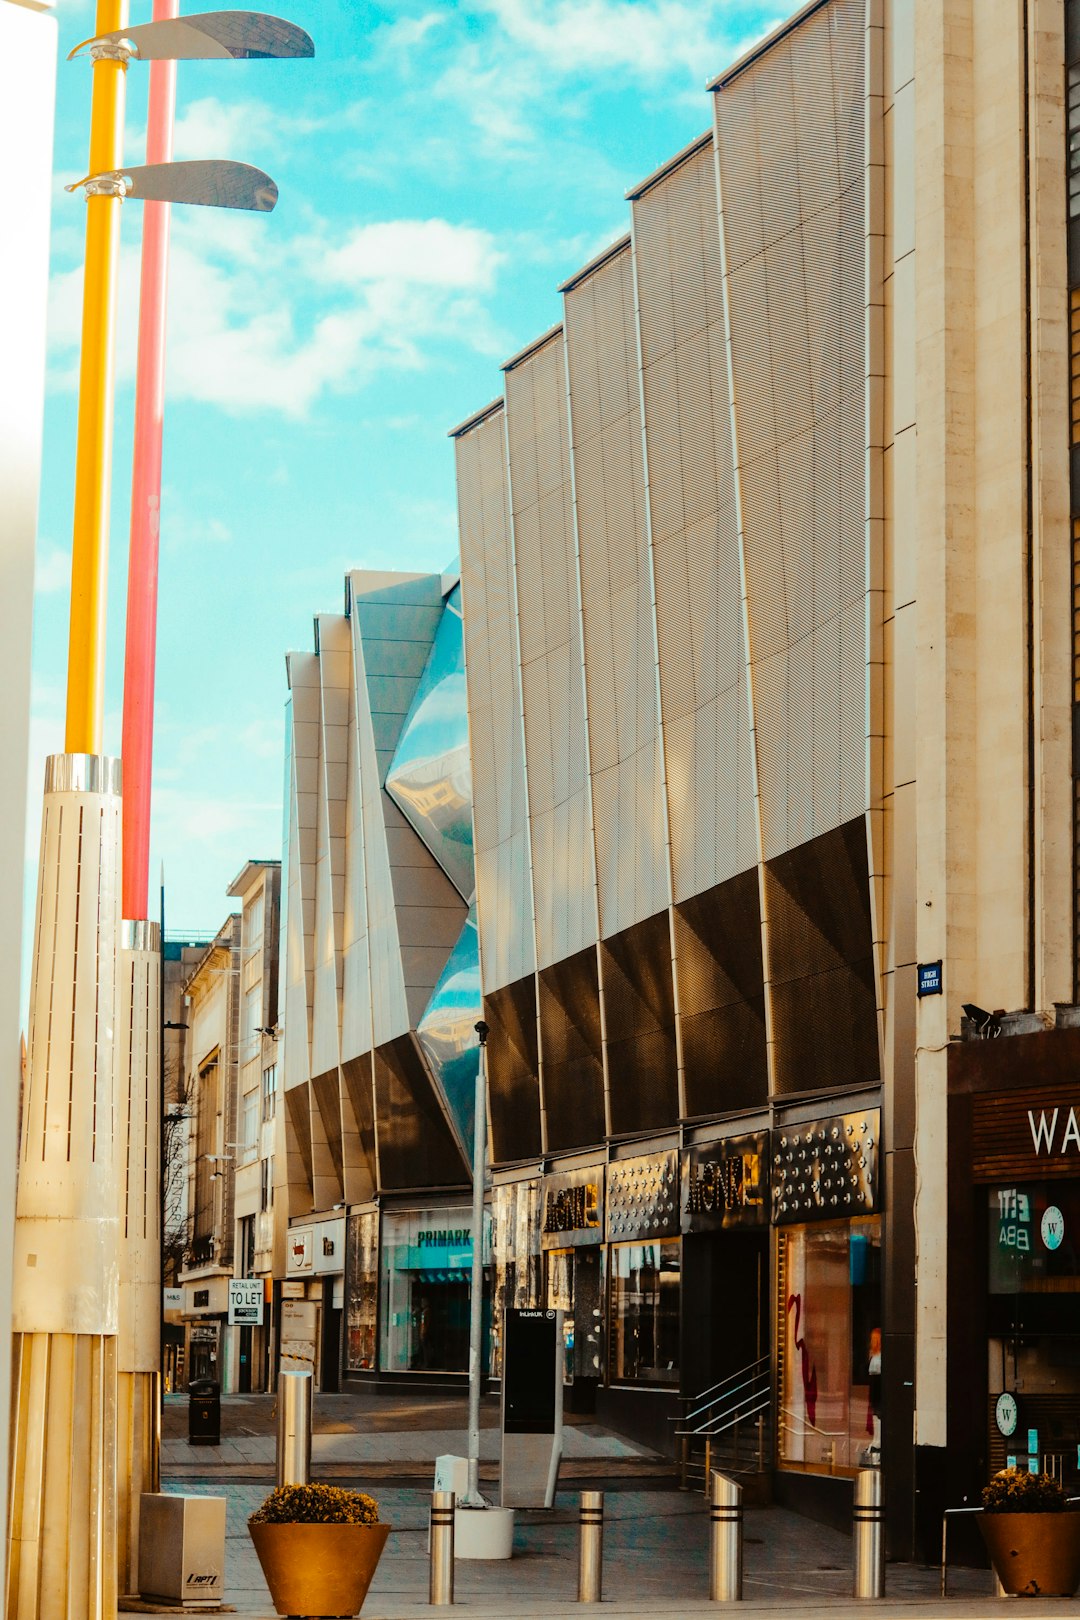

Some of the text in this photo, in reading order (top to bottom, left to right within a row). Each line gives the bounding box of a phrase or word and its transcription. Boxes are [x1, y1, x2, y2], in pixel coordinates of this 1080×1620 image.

[921, 979, 939, 989] STREET
[1028, 1106, 1080, 1156] WA
[418, 1229, 471, 1248] PRIMARK
[232, 1282, 261, 1290] RETAIL UNIT
[230, 1292, 262, 1305] TO LET
[1002, 1408, 1012, 1422] W
